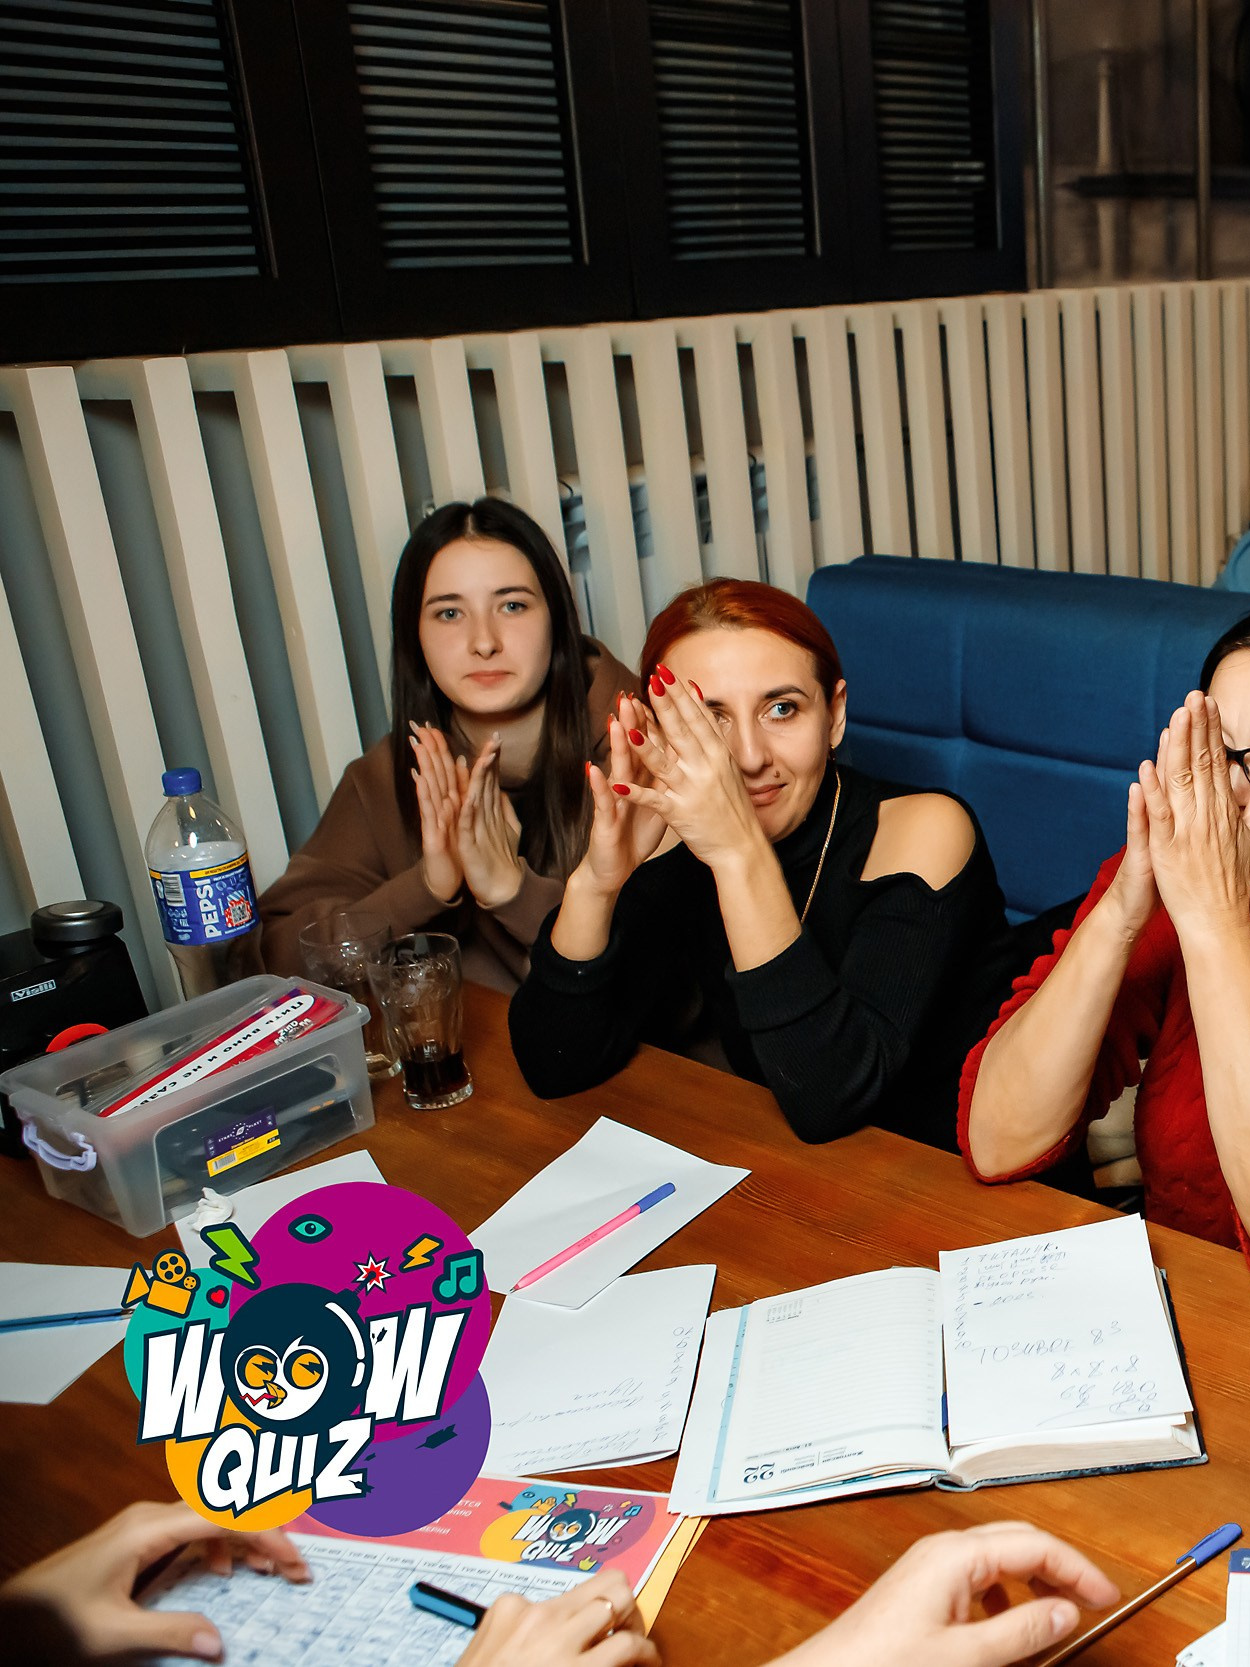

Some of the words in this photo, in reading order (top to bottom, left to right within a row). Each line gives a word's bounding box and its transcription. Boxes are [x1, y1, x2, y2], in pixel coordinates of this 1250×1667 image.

[194, 879, 222, 938] PEPSI
[265, 1000, 304, 1025] Пить
[222, 1027, 261, 1053] вино
[182, 1065, 203, 1078] не
[207, 1055, 218, 1063] и
[134, 1081, 177, 1108] сдав
[743, 1462, 775, 1485] 22
[511, 1508, 629, 1545] WOW
[520, 1540, 584, 1563] QUIZ
